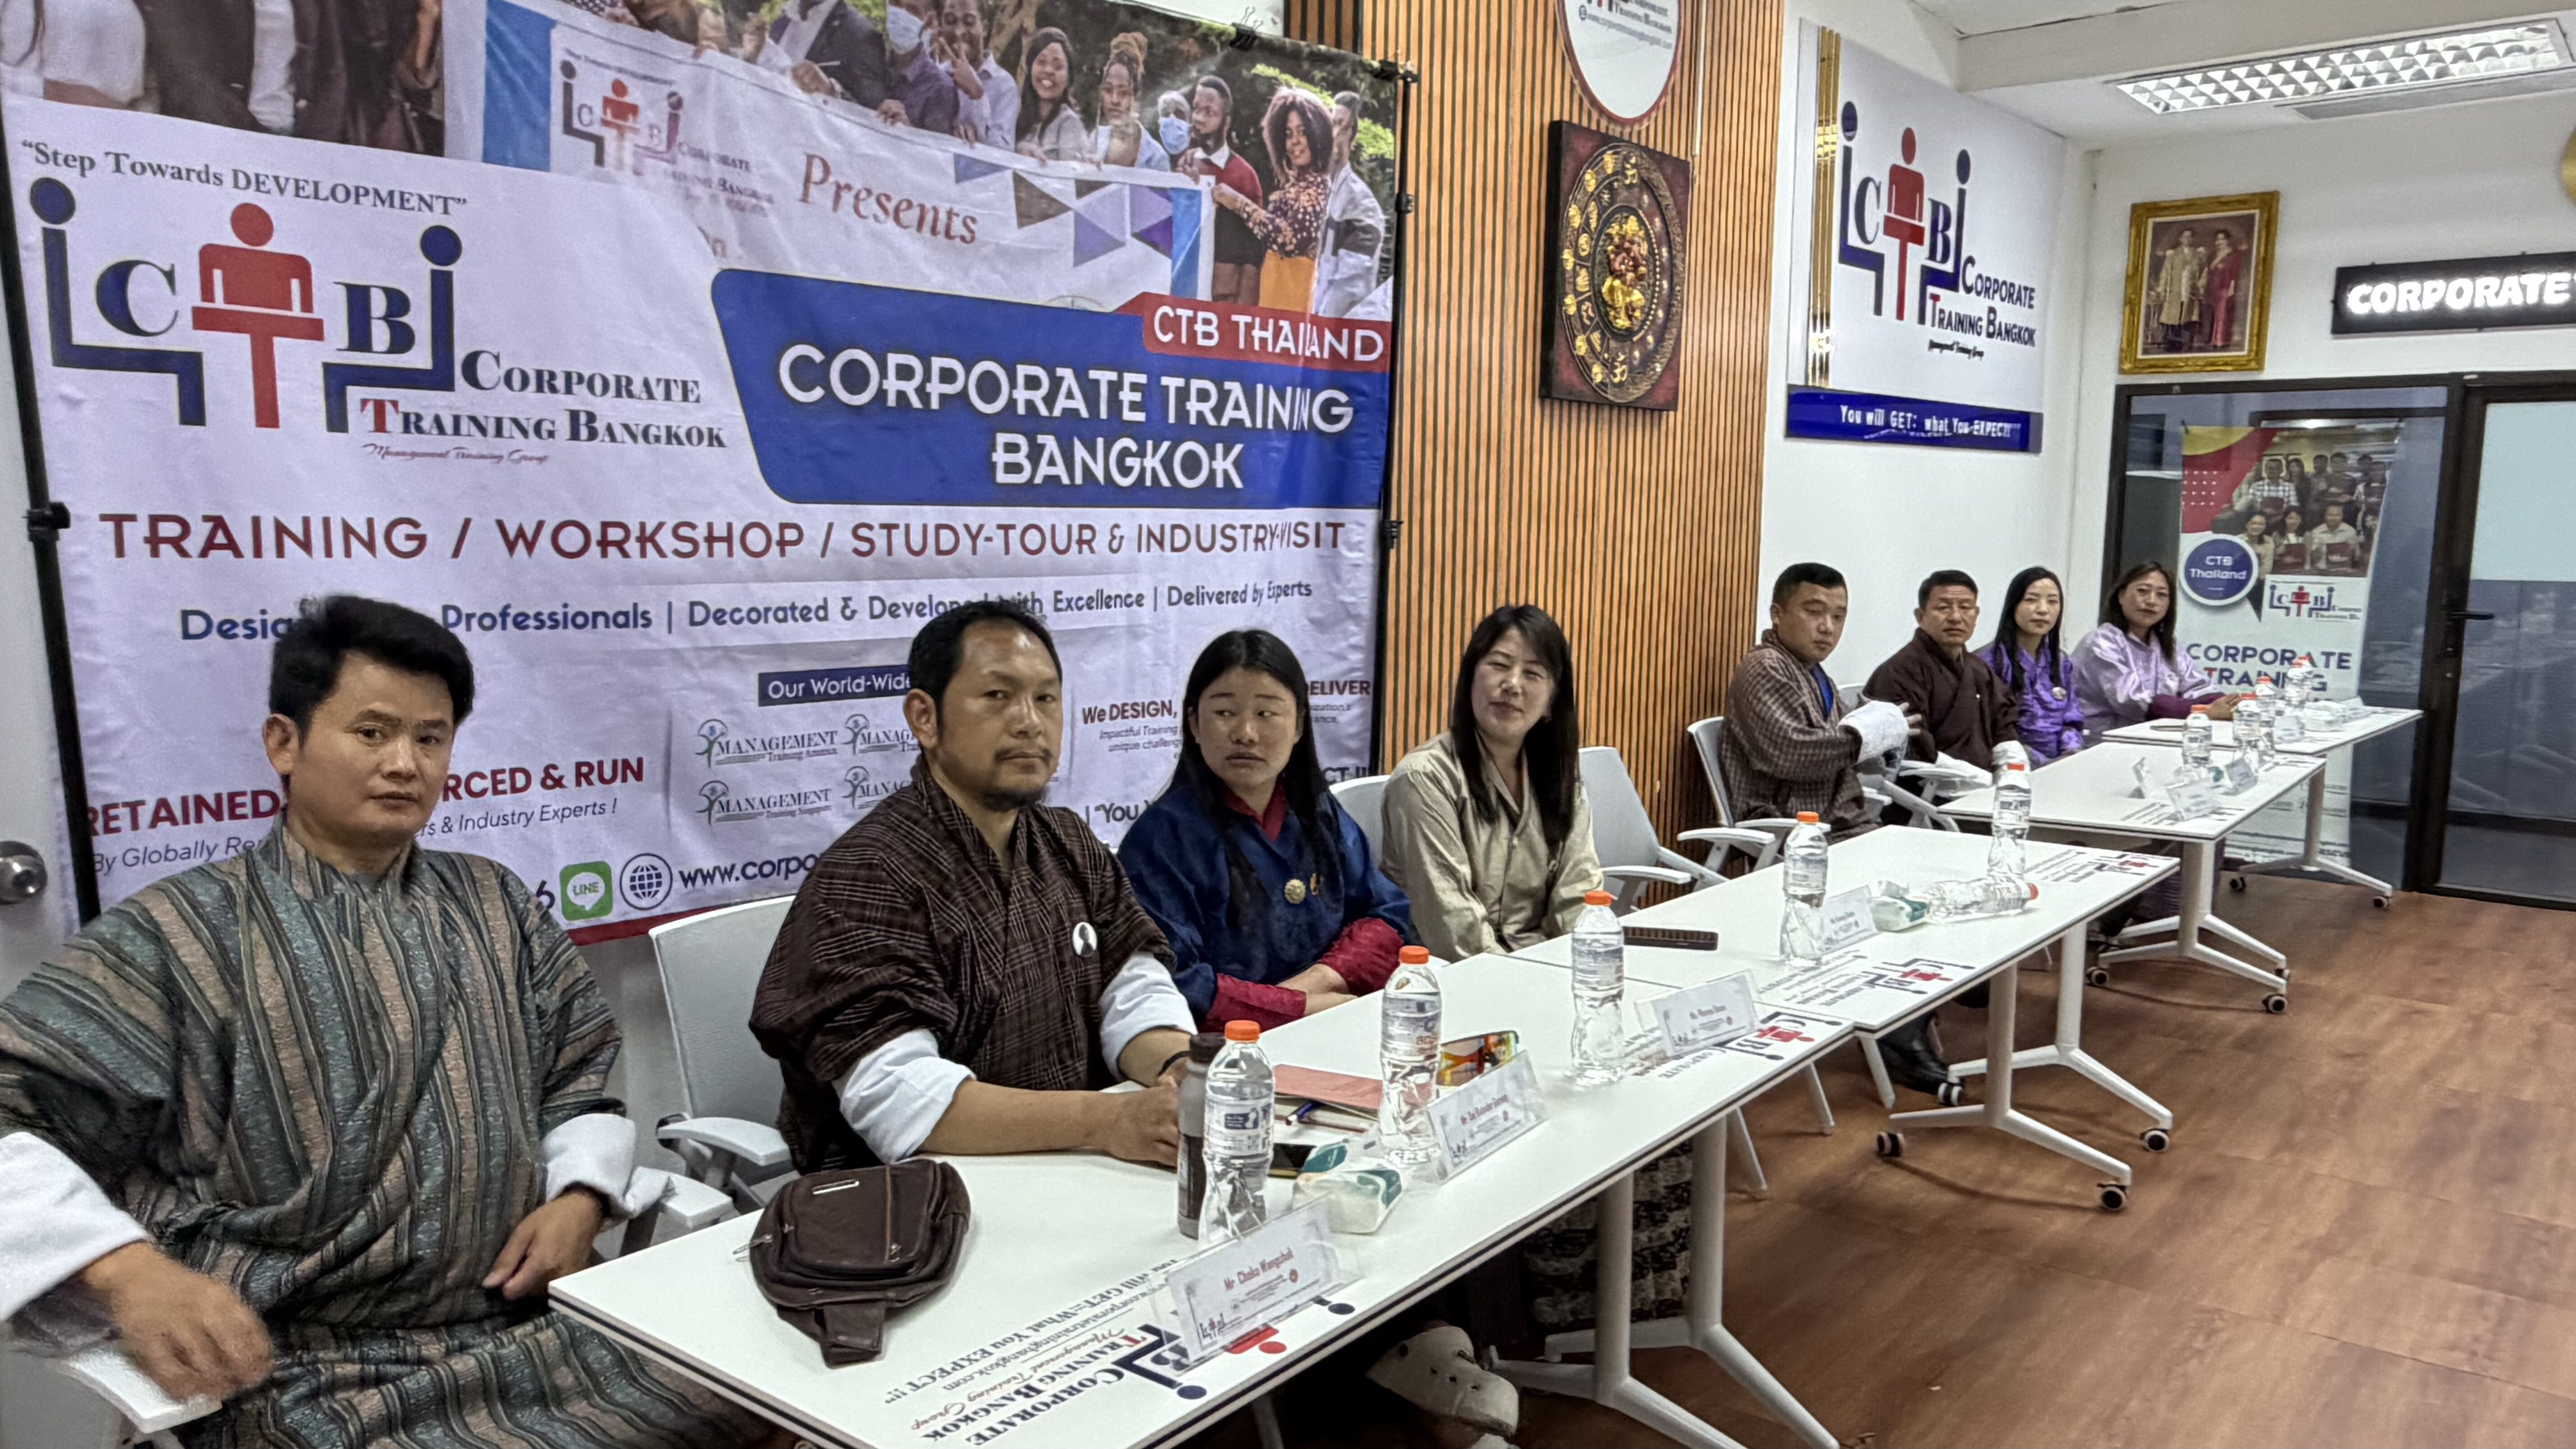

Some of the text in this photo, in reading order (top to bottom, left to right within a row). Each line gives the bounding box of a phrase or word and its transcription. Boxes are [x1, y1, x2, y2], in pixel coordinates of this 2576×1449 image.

[105, 151, 223, 186] Towards
[797, 152, 978, 245] Presents
[1961, 255, 2035, 309] CORPORATE
[2346, 272, 2572, 314] CORPORATE
[1154, 305, 1218, 346] CTB
[1929, 293, 2036, 347] TRAINING BANGKOK
[461, 350, 701, 404] CORPORATE
[778, 344, 1353, 433] CORPORATE TRAINING
[360, 399, 727, 448] TRAINING BANGKOK
[1840, 405, 1862, 424] You
[1866, 409, 1885, 427] will
[992, 433, 1244, 489] BANGKOK
[99, 513, 427, 559] TRAINING
[495, 519, 805, 559] WORKSHOP
[851, 521, 1096, 558] STUDY-TOUR
[1108, 523, 1124, 554] &
[1137, 522, 1346, 553] INDUSTRY-VISIT
[2189, 568, 2246, 580] Thailand
[2205, 556, 2233, 566] CTB
[442, 603, 652, 633] Professionals
[688, 599, 829, 627] Decorated
[840, 596, 857, 621] &
[1053, 588, 1145, 612] Excellence
[1167, 584, 1247, 607] Delivered
[1252, 582, 1263, 606] by
[768, 680, 805, 699] Our
[2204, 667, 2328, 691] TRAINIG
[1082, 681, 1371, 724] We DESIGN, ELIVER
[716, 730, 838, 756] MANAGEMENT
[1143, 725, 1178, 736] Training
[87, 790, 281, 837] RETAINED
[541, 764, 568, 791] &
[575, 757, 644, 788] RUN
[716, 788, 831, 813] MANAGEMENT
[121, 840, 219, 868] Globally
[442, 816, 453, 833] &
[459, 810, 534, 832] Industry
[539, 800, 606, 823] Experts
[573, 882, 599, 896] LINE
[989, 1327, 1030, 1352] You
[906, 1347, 994, 1393] EXPECT
[911, 1328, 1125, 1431] Management Training Group
[921, 1333, 1148, 1442] TRAINING BANGKOK
[965, 1368, 1125, 1446] CORPORATE
